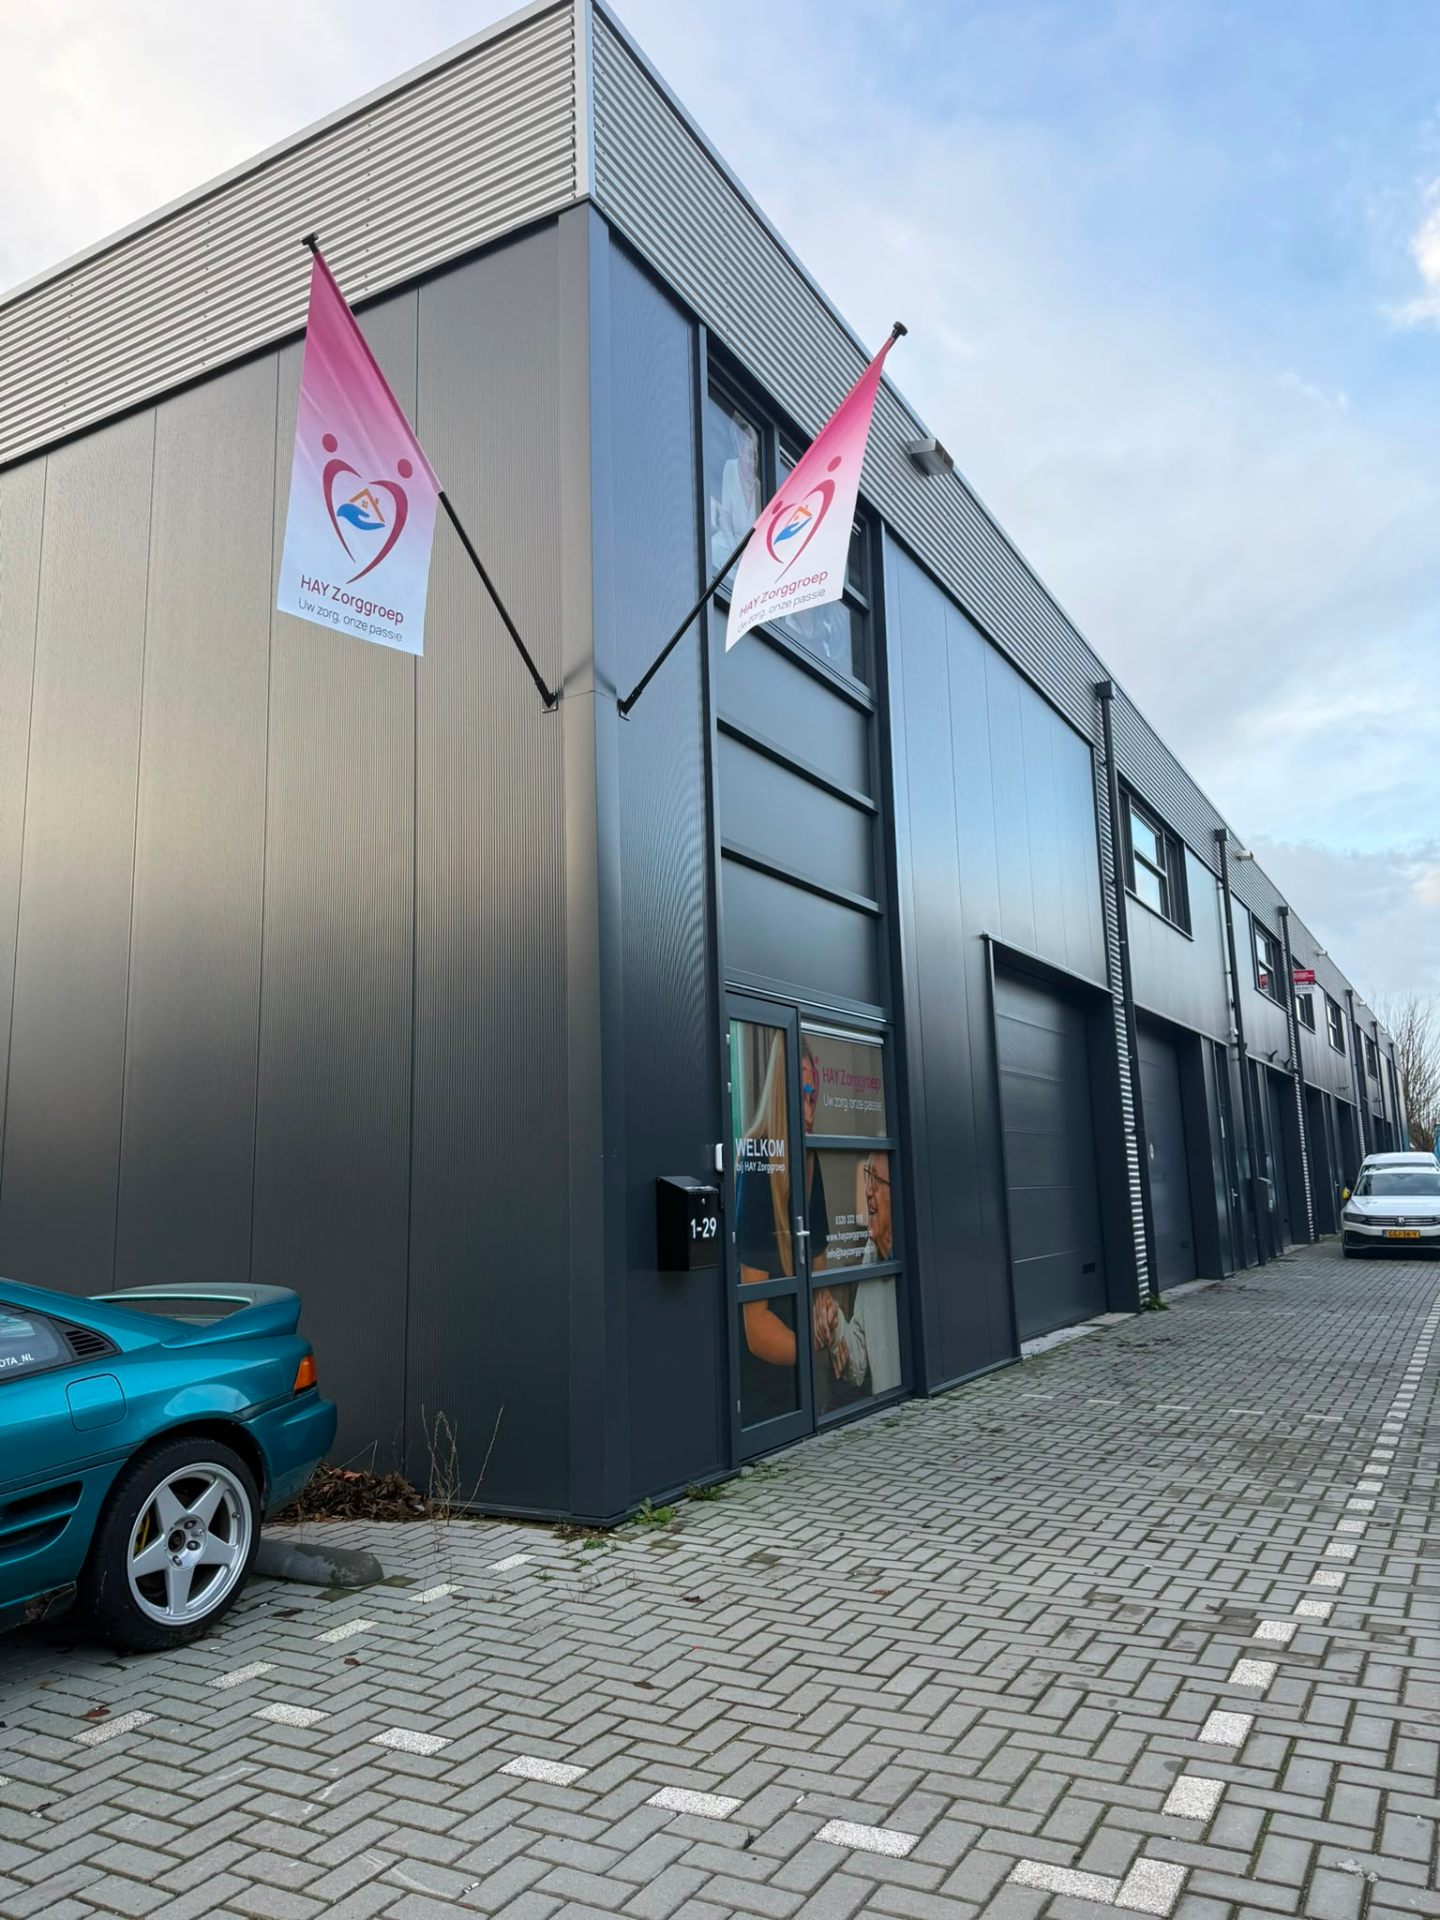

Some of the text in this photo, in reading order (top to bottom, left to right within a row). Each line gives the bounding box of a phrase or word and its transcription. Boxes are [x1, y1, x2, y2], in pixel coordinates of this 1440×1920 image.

[300, 574, 404, 626] HAY Zorggroep
[740, 571, 829, 618] HAY Zorggroep
[793, 588, 826, 608] passie
[298, 597, 314, 612] Uw
[343, 615, 368, 631] onze
[368, 625, 403, 642] passie
[823, 1066, 840, 1085] HAY
[735, 1137, 785, 1157] WELKOM
[744, 1161, 757, 1172] HAY
[757, 1161, 786, 1174] Zorggroep
[690, 1217, 717, 1239] 1-29
[0, 1353, 35, 1368] OTA_NL
